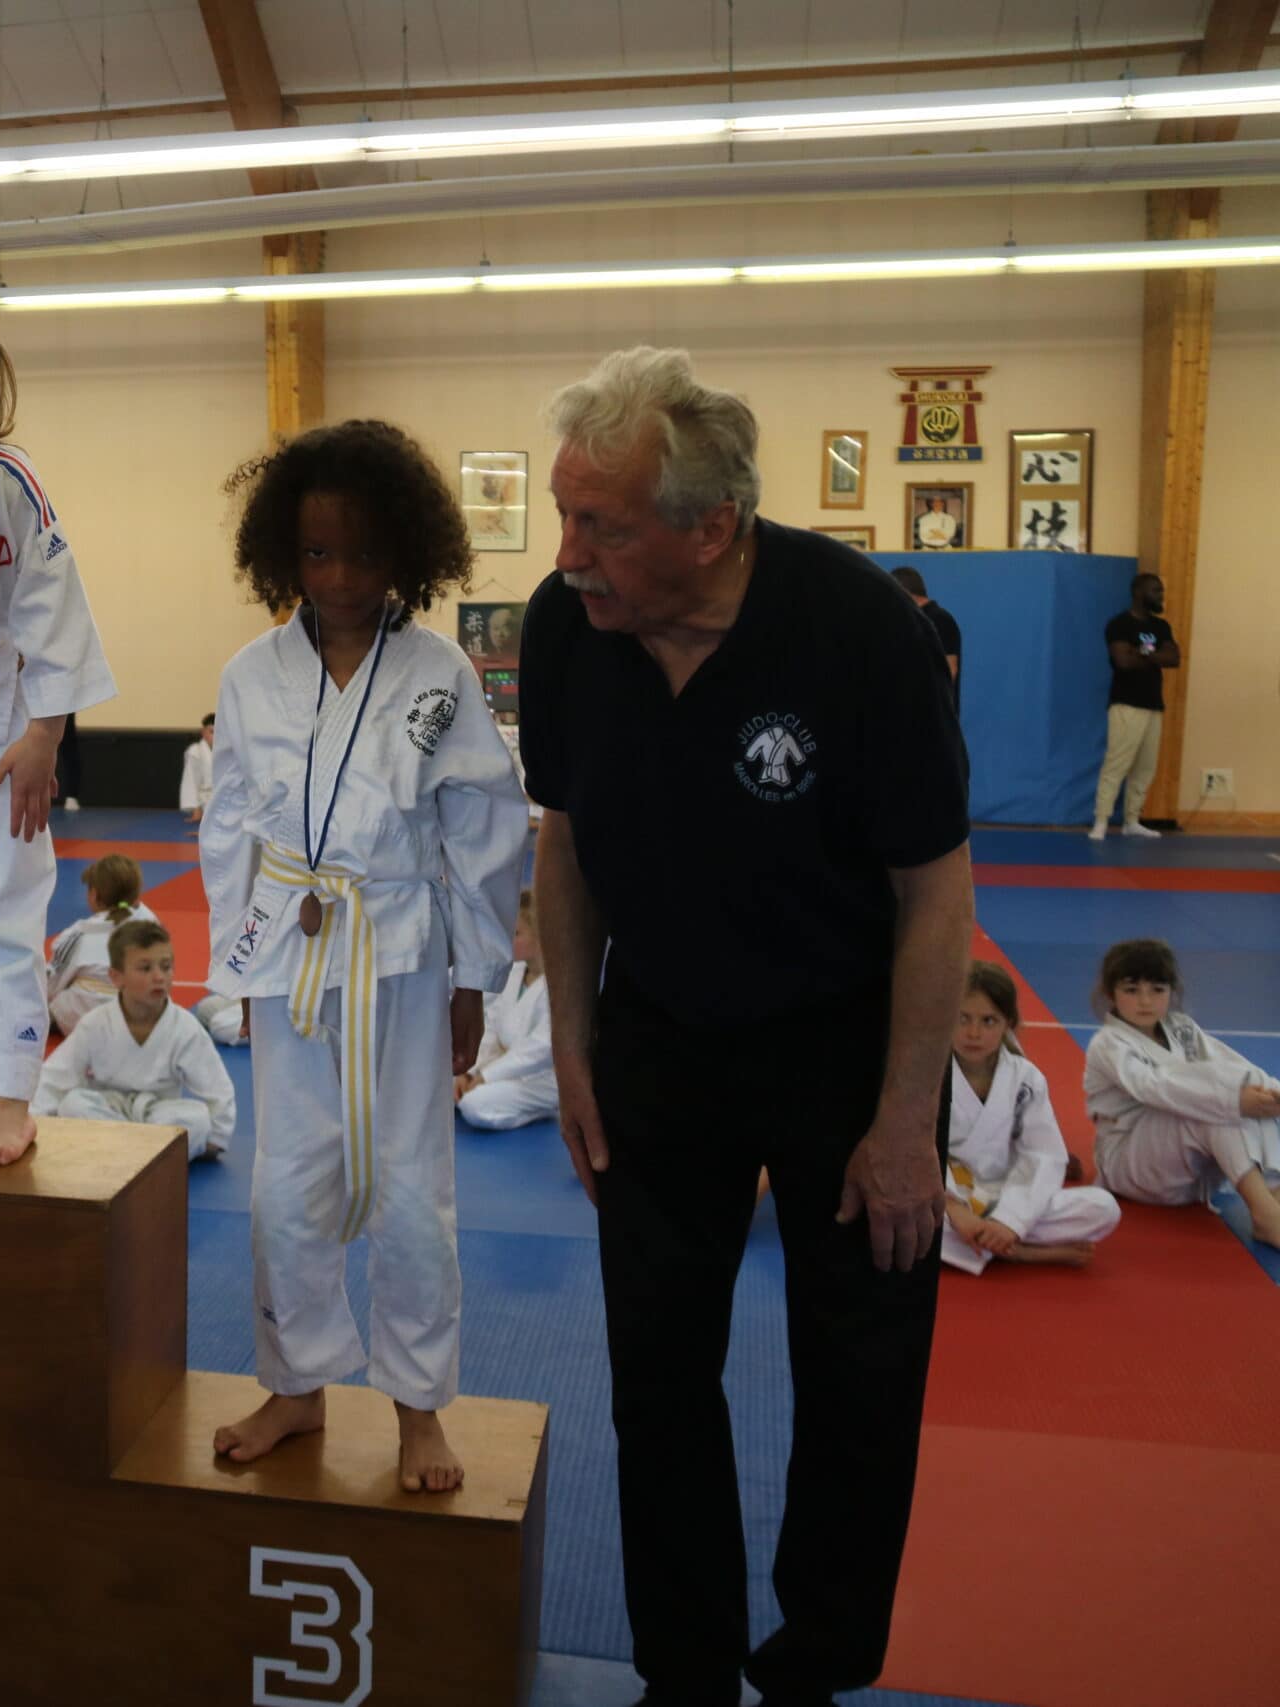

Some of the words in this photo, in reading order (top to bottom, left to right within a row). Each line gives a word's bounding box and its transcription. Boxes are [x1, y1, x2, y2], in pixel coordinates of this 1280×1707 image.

[1023, 451, 1078, 482] 心
[429, 688, 449, 697] CINQ
[735, 711, 817, 753] JUDO-CLUB
[249, 1545, 373, 1707] 3
